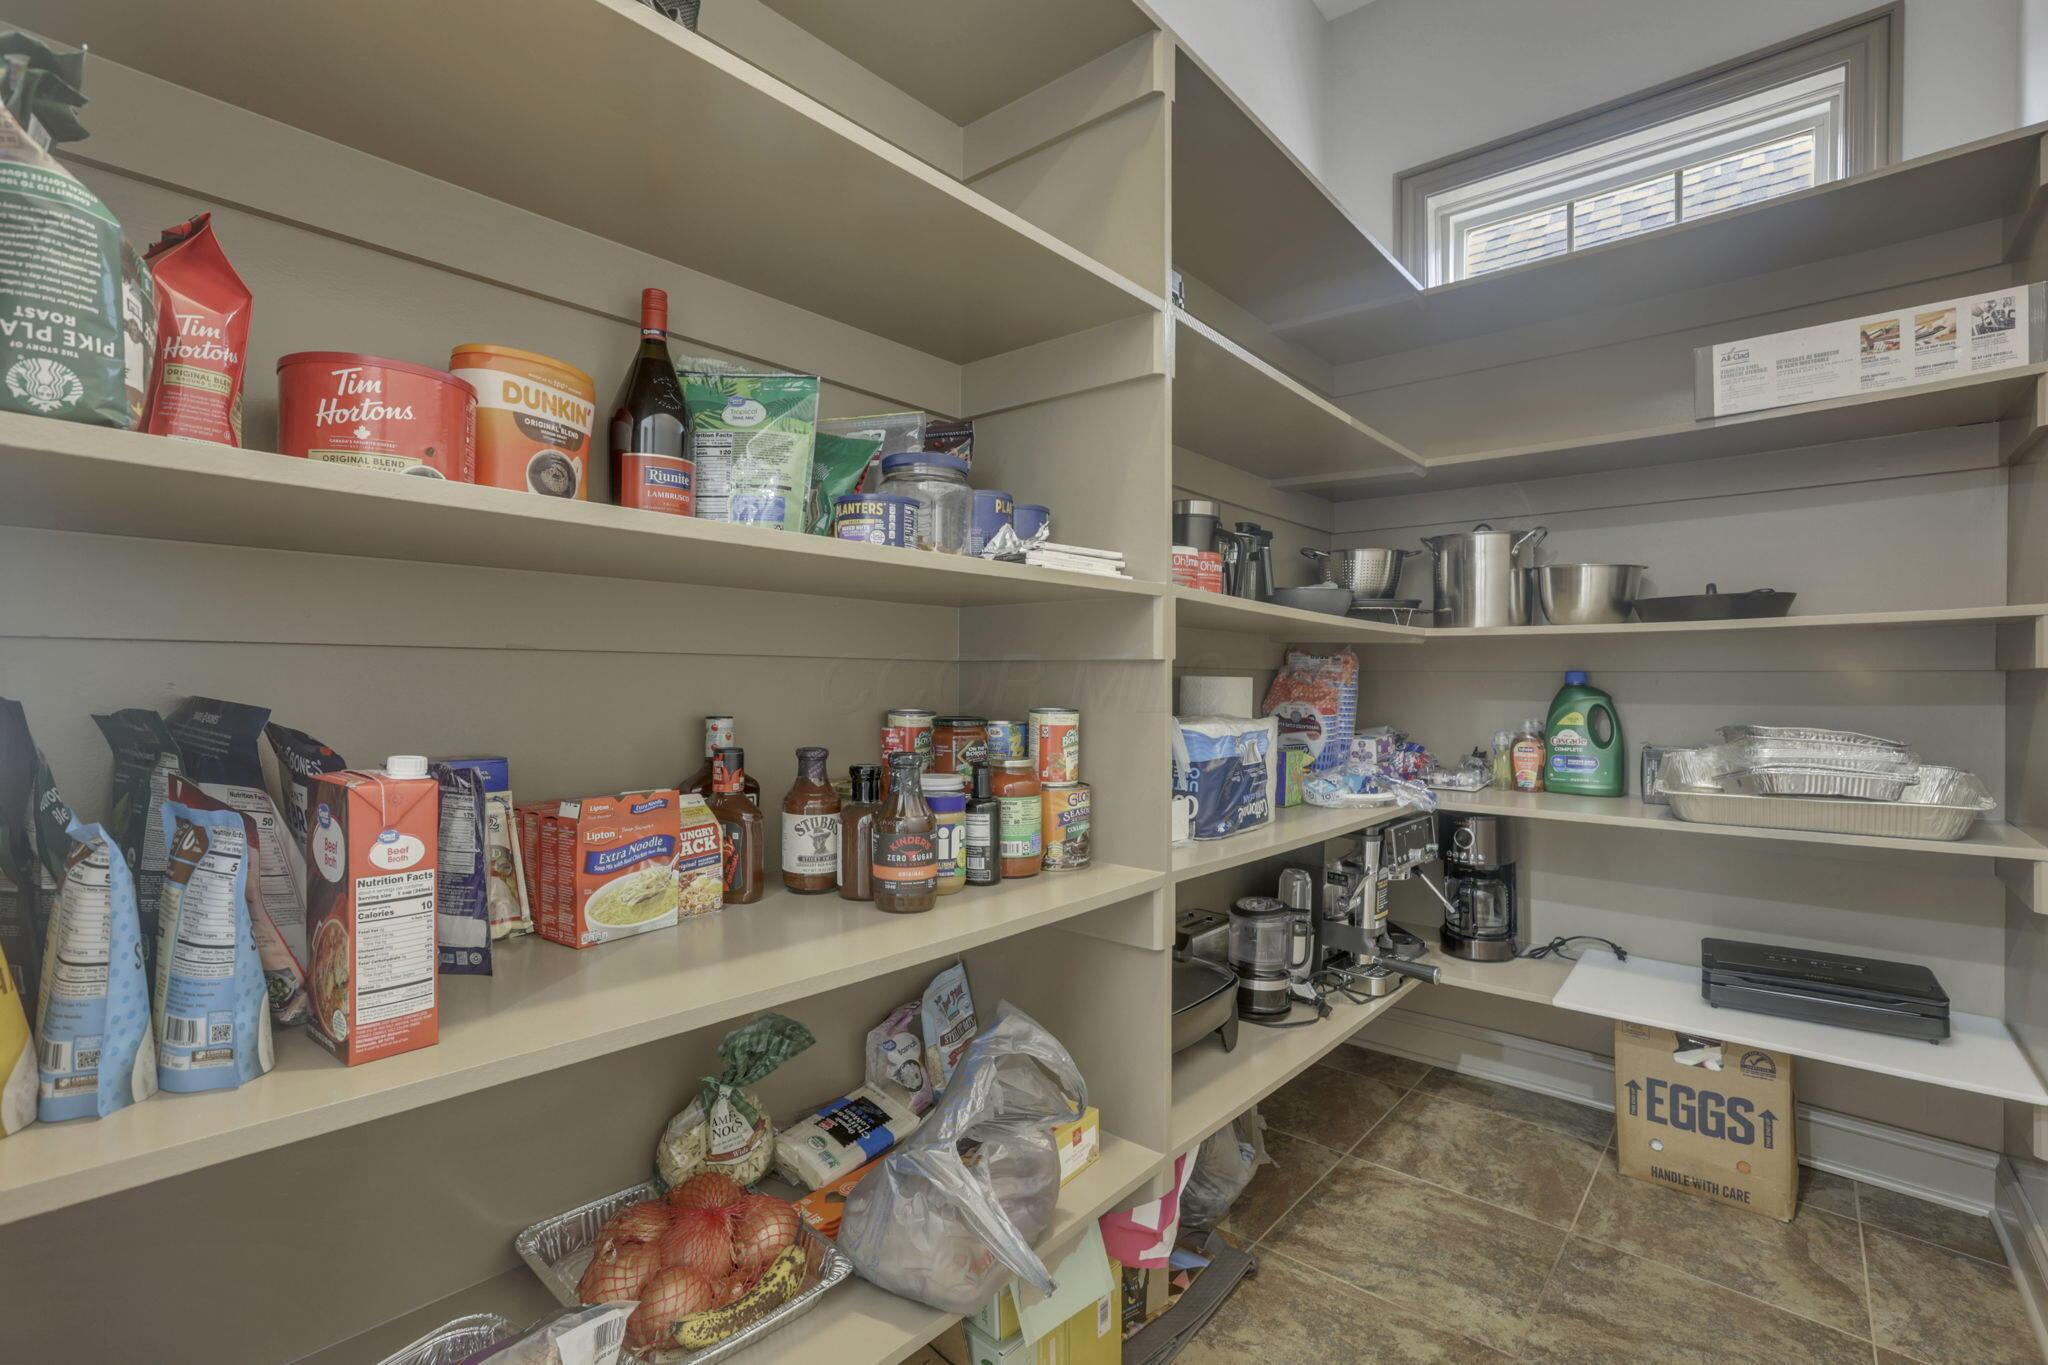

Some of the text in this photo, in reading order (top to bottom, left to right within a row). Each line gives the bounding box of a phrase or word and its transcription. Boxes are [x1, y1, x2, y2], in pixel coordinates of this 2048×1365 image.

[13, 305, 76, 327] ROAST
[176, 314, 221, 339] Tim
[0, 319, 115, 358] PIKE PLA
[9, 340, 80, 359] THE STORY OF
[164, 335, 239, 364] Hortons
[166, 368, 211, 382] ORIGINAL
[331, 367, 382, 396] Tim
[502, 380, 592, 426] DUNKIN'
[315, 398, 413, 427] Hortons
[524, 417, 579, 439] ORIGINAL BLEND
[322, 454, 406, 468] ORIGINAL BLEND
[649, 469, 690, 486] Riunite
[647, 490, 690, 502] LAMBRUSCO
[836, 503, 883, 518] PLANTERS
[1550, 735, 1588, 746] Cascade
[288, 753, 322, 776] BONES
[1067, 792, 1089, 807] GLO
[262, 818, 274, 828] 50
[1062, 807, 1090, 822] SEASO
[586, 830, 616, 842] Lipton
[680, 826, 714, 841] UNGRY
[324, 837, 338, 854] Beef
[387, 845, 410, 856] Beef
[598, 836, 663, 865] Extra Noodle
[680, 836, 718, 857] ACK
[387, 855, 409, 863] Broth
[593, 864, 606, 872] Soup
[632, 852, 648, 861] Chicken
[887, 852, 933, 862] ZERO SUGAR
[679, 860, 697, 872] riginal
[357, 871, 433, 888] Nutrition Facts
[358, 900, 433, 920] Calories 10
[1646, 1076, 1756, 1145] EGGS
[732, 1147, 749, 1157] Wide
[1651, 1165, 1751, 1204] HANDLE WITH CARE
